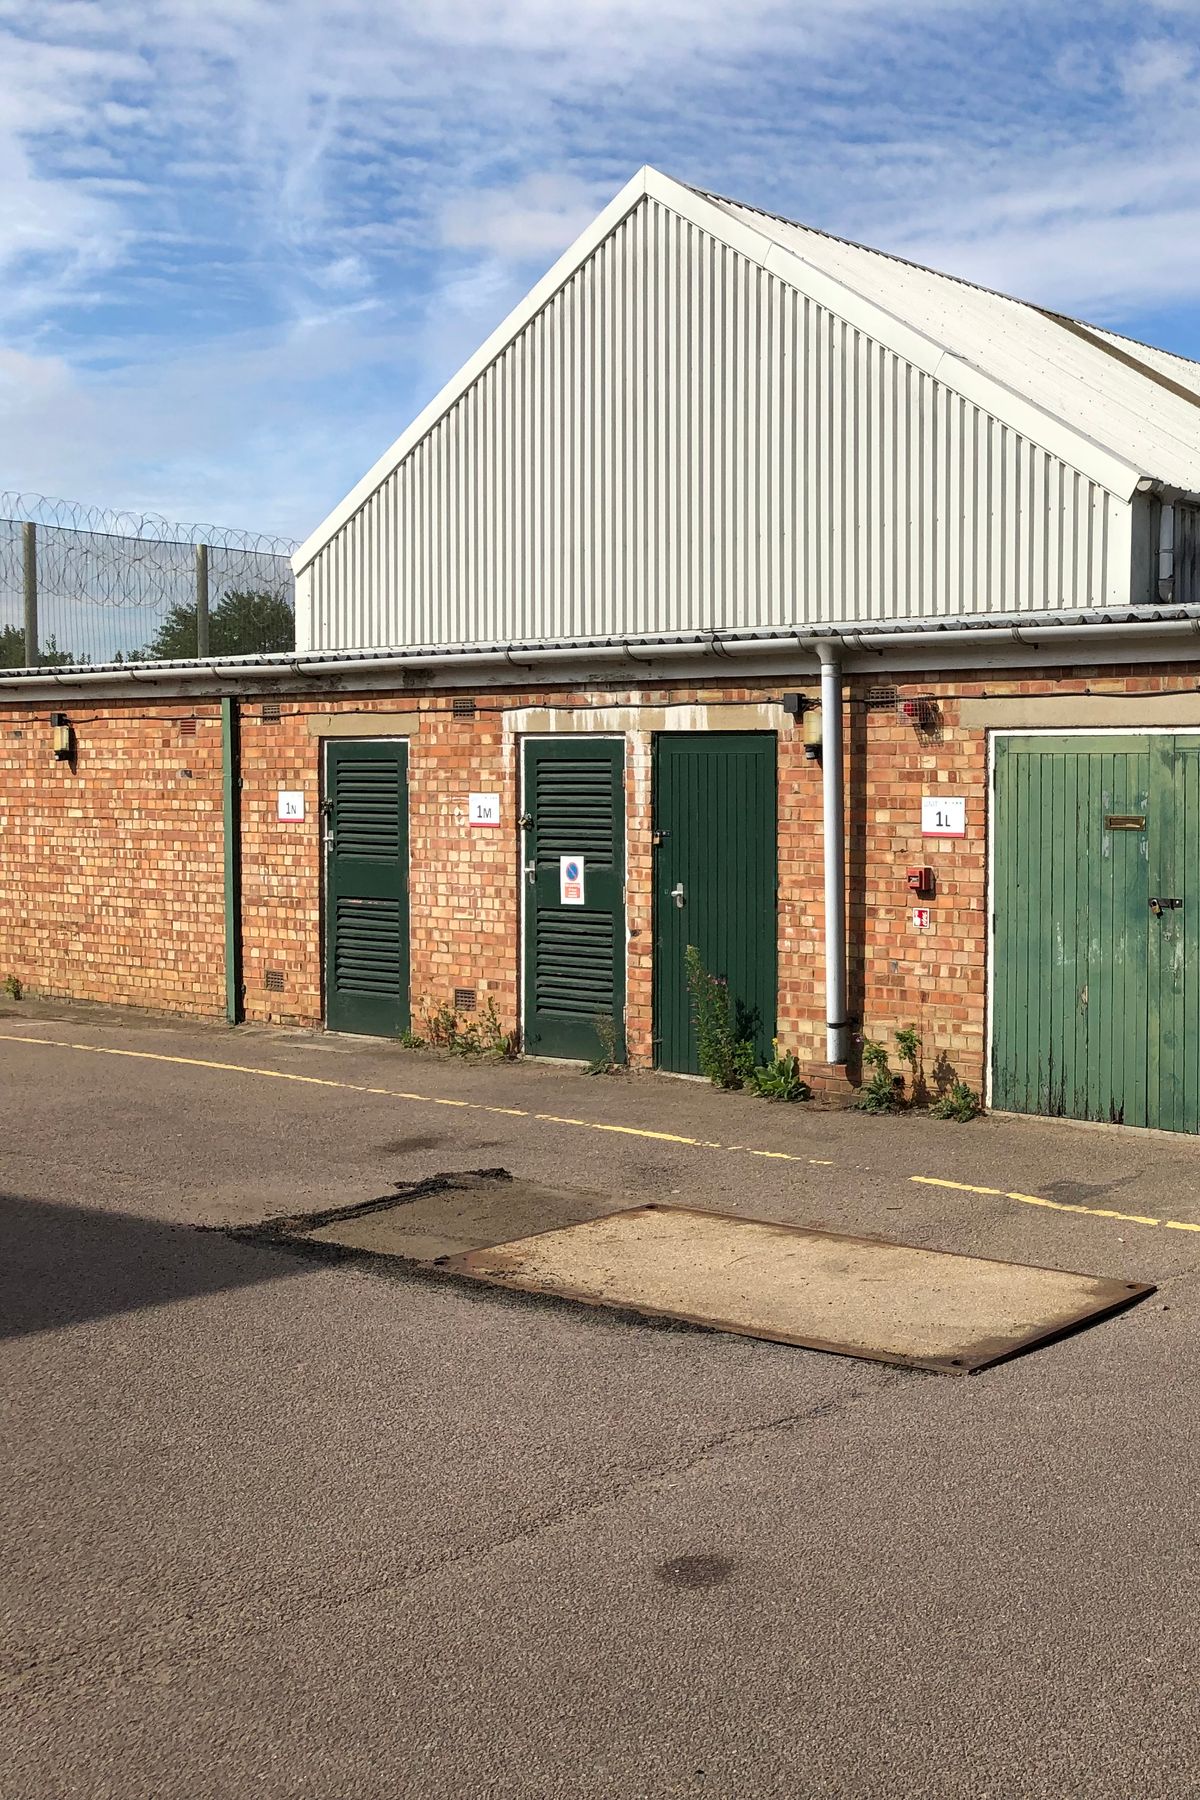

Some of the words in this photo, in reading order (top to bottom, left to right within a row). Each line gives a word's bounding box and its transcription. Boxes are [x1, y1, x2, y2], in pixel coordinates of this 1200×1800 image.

[286, 801, 297, 815] 1N
[477, 804, 492, 819] 1M
[935, 811, 951, 827] 1L
